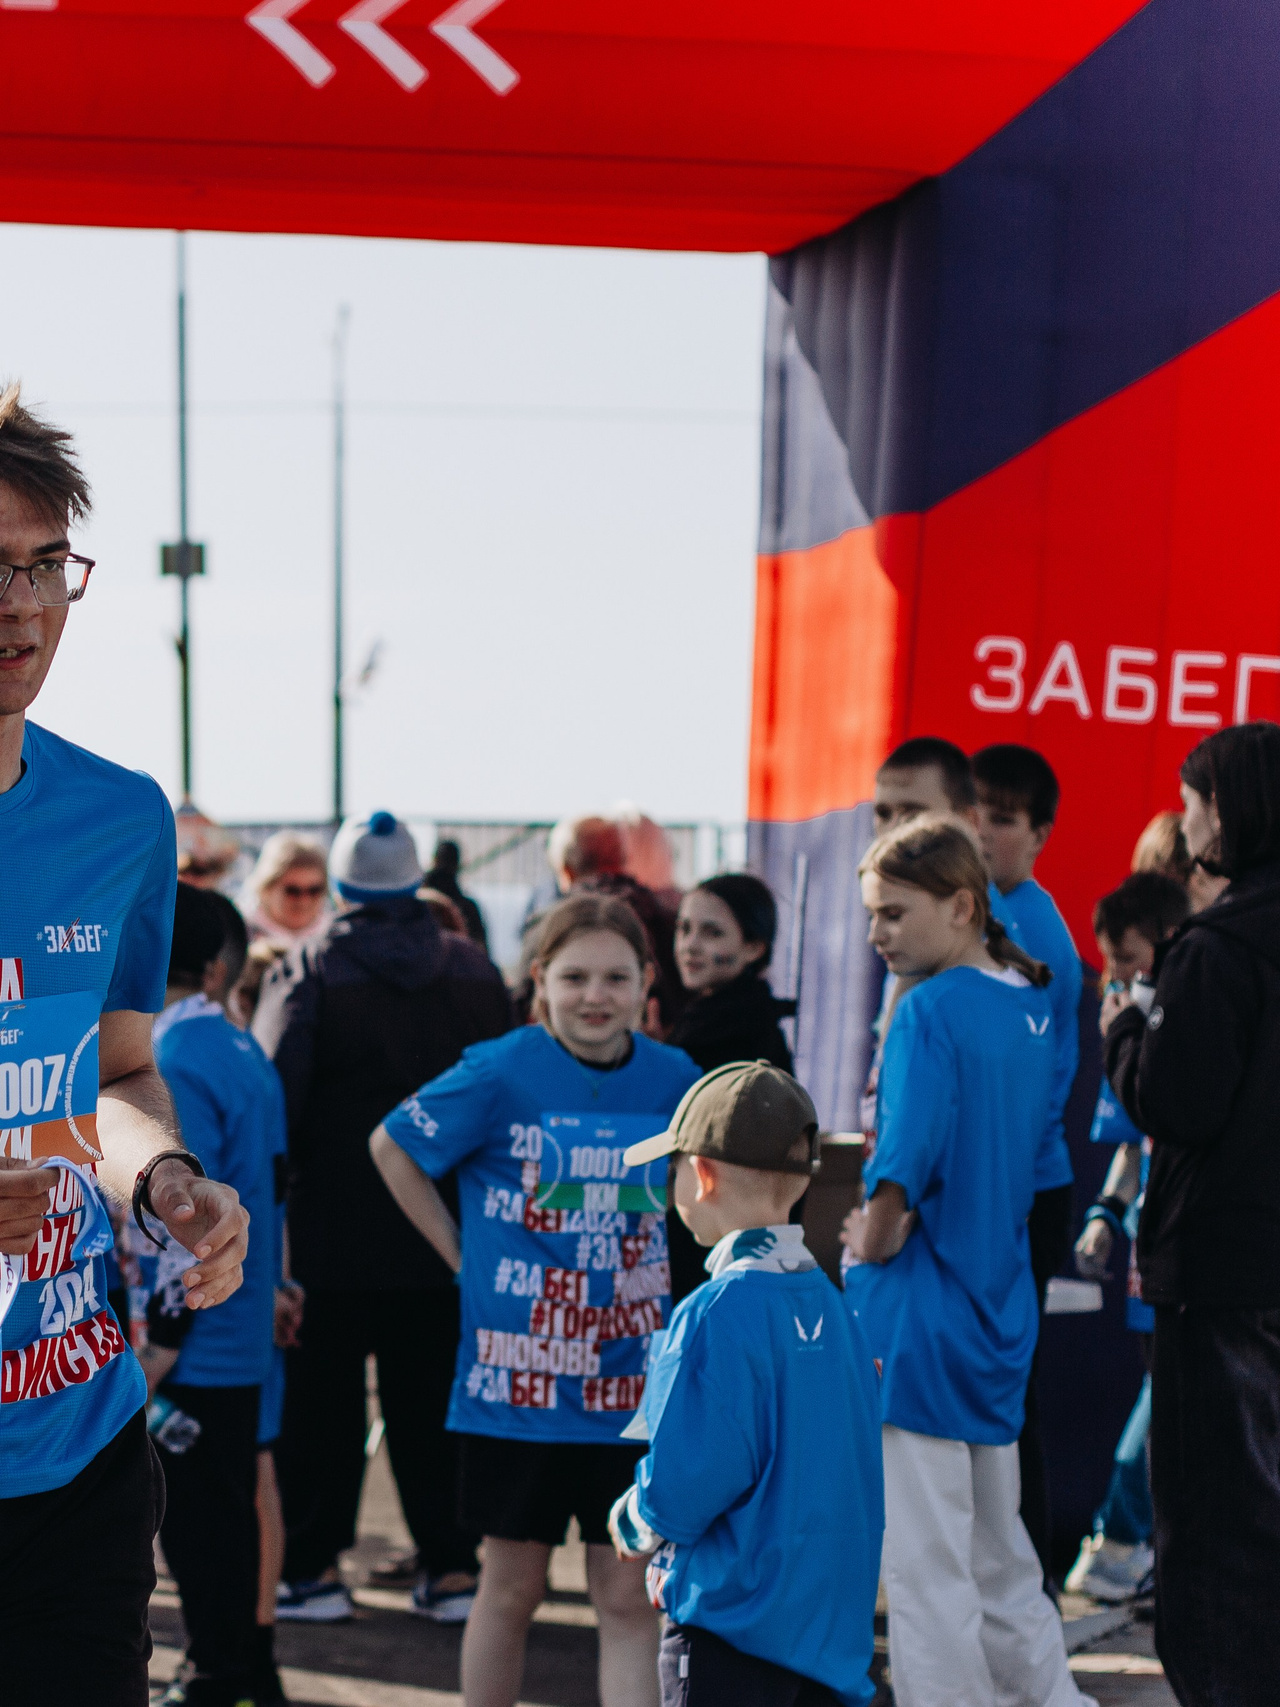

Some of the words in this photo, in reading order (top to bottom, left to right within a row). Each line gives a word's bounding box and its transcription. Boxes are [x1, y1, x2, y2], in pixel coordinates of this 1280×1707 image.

[971, 635, 1280, 729] ЗАБЕГ
[495, 1257, 587, 1304] #ЗАБЕГ
[477, 1329, 600, 1376] #ЛЮБОВЬ
[467, 1365, 556, 1409] #ЗАБЕГ
